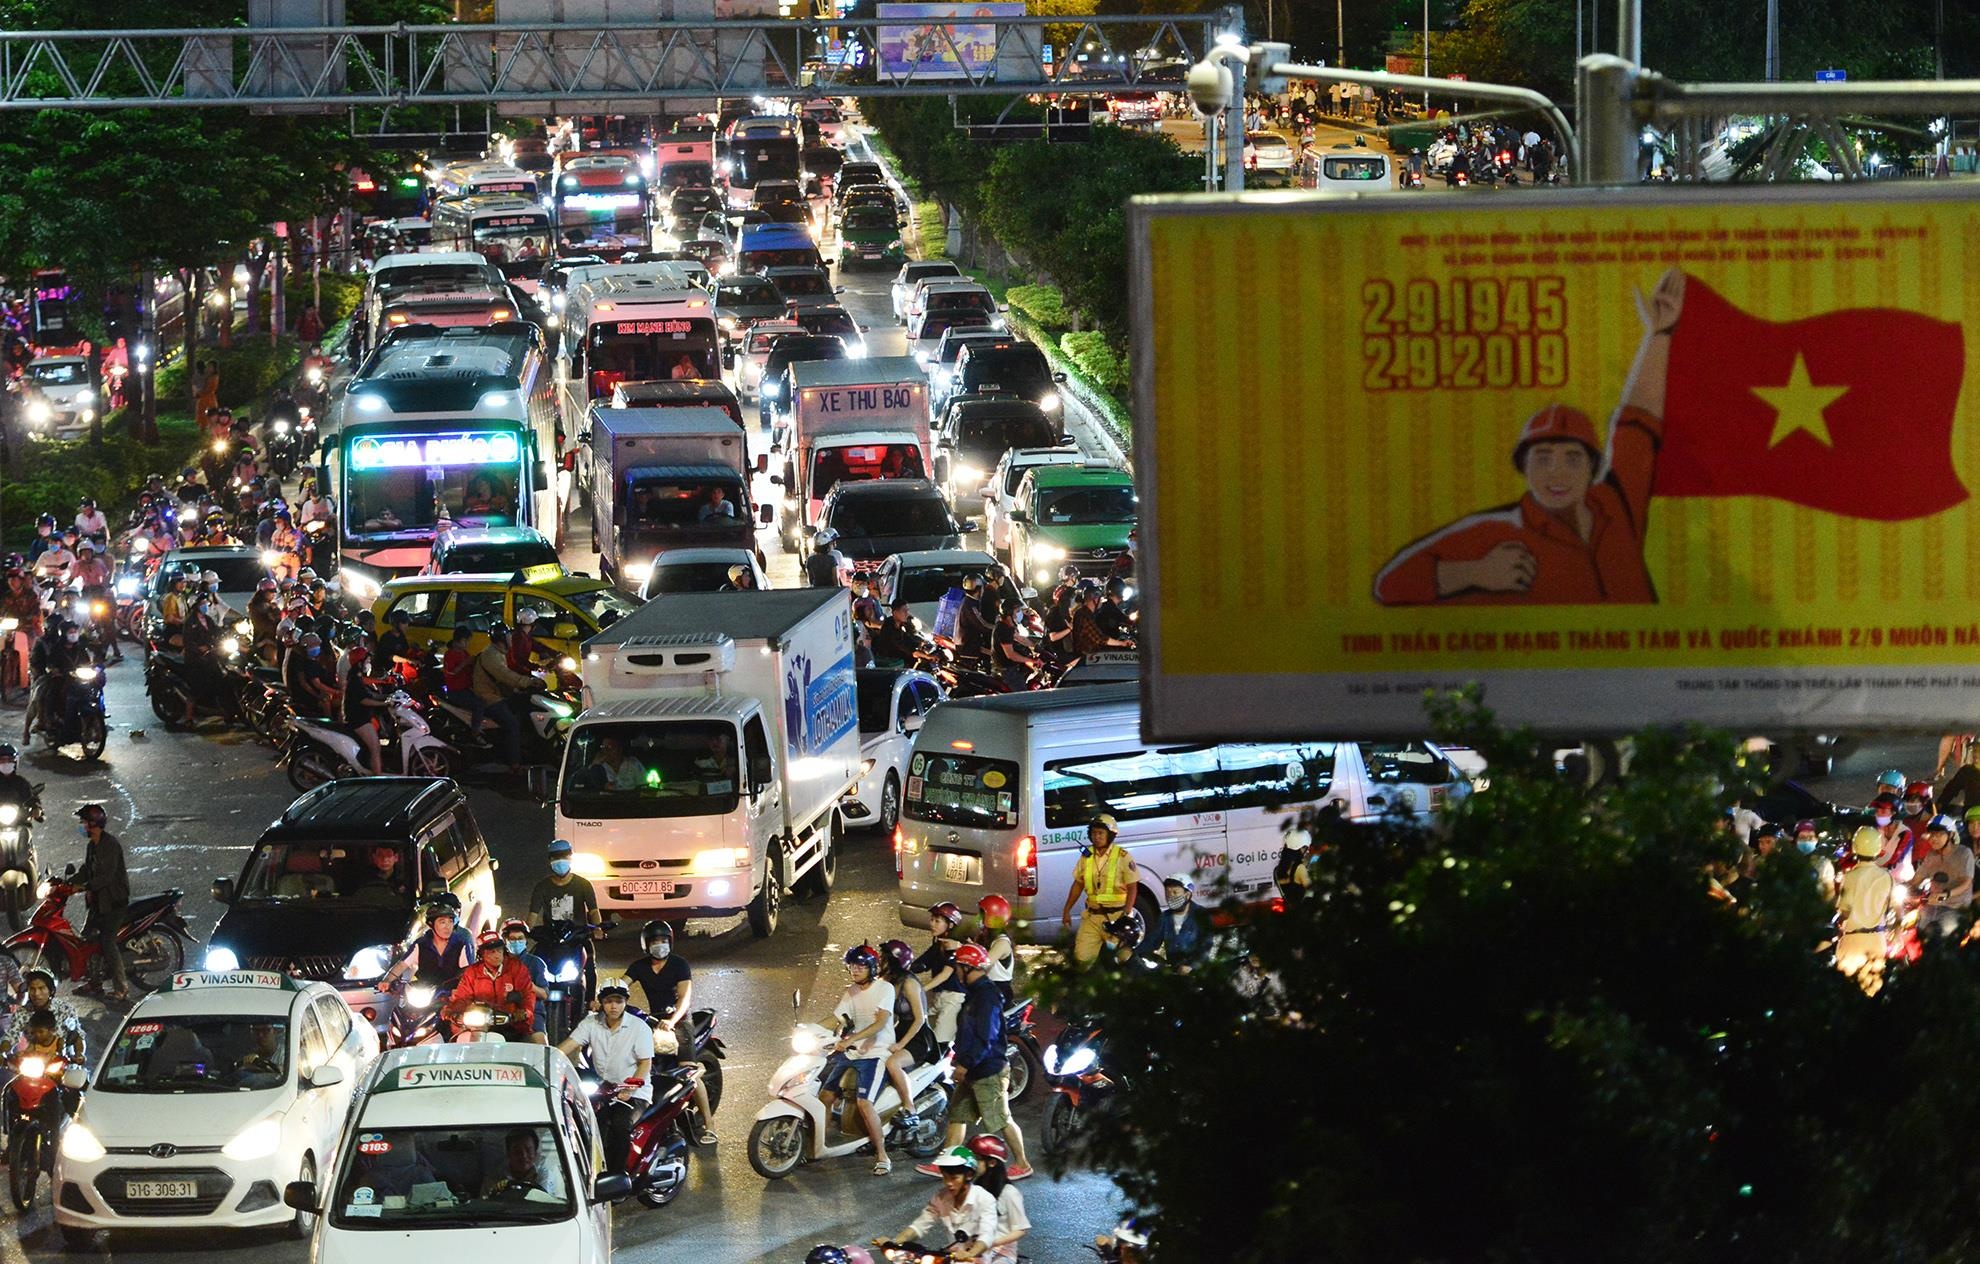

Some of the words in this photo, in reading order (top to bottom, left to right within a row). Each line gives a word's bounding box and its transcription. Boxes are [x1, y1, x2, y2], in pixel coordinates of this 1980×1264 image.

[1362, 276, 1568, 335] 2.9.1945
[617, 322, 636, 334] KIM
[637, 322, 664, 336] MẠNH
[664, 320, 692, 333] HÙNG
[1362, 332, 1569, 393] 2.9.2019
[819, 392, 841, 413] XE
[883, 382, 910, 409] BÁO
[1446, 630, 1497, 651] CÁCH
[1504, 631, 1560, 655] MẠNG
[1568, 628, 1631, 650] THÁNG
[1637, 627, 1680, 649] TÁM
[1720, 624, 1772, 650] QUỐC
[1778, 624, 1843, 648] KHÁNH
[1849, 627, 1883, 647] 2/9
[1889, 624, 1947, 647] MUÔN
[1289, 766, 1301, 778] 05
[1042, 830, 1088, 845] 51B-407.
[1236, 851, 1255, 866] Gọi
[1257, 850, 1268, 861] là
[622, 881, 673, 893] 60C-371.85
[200, 974, 254, 985] VINASUN
[256, 974, 280, 985] TAXI
[428, 1069, 492, 1081] VINASUN
[495, 1069, 523, 1081] TAXI
[360, 1142, 389, 1152] 8103
